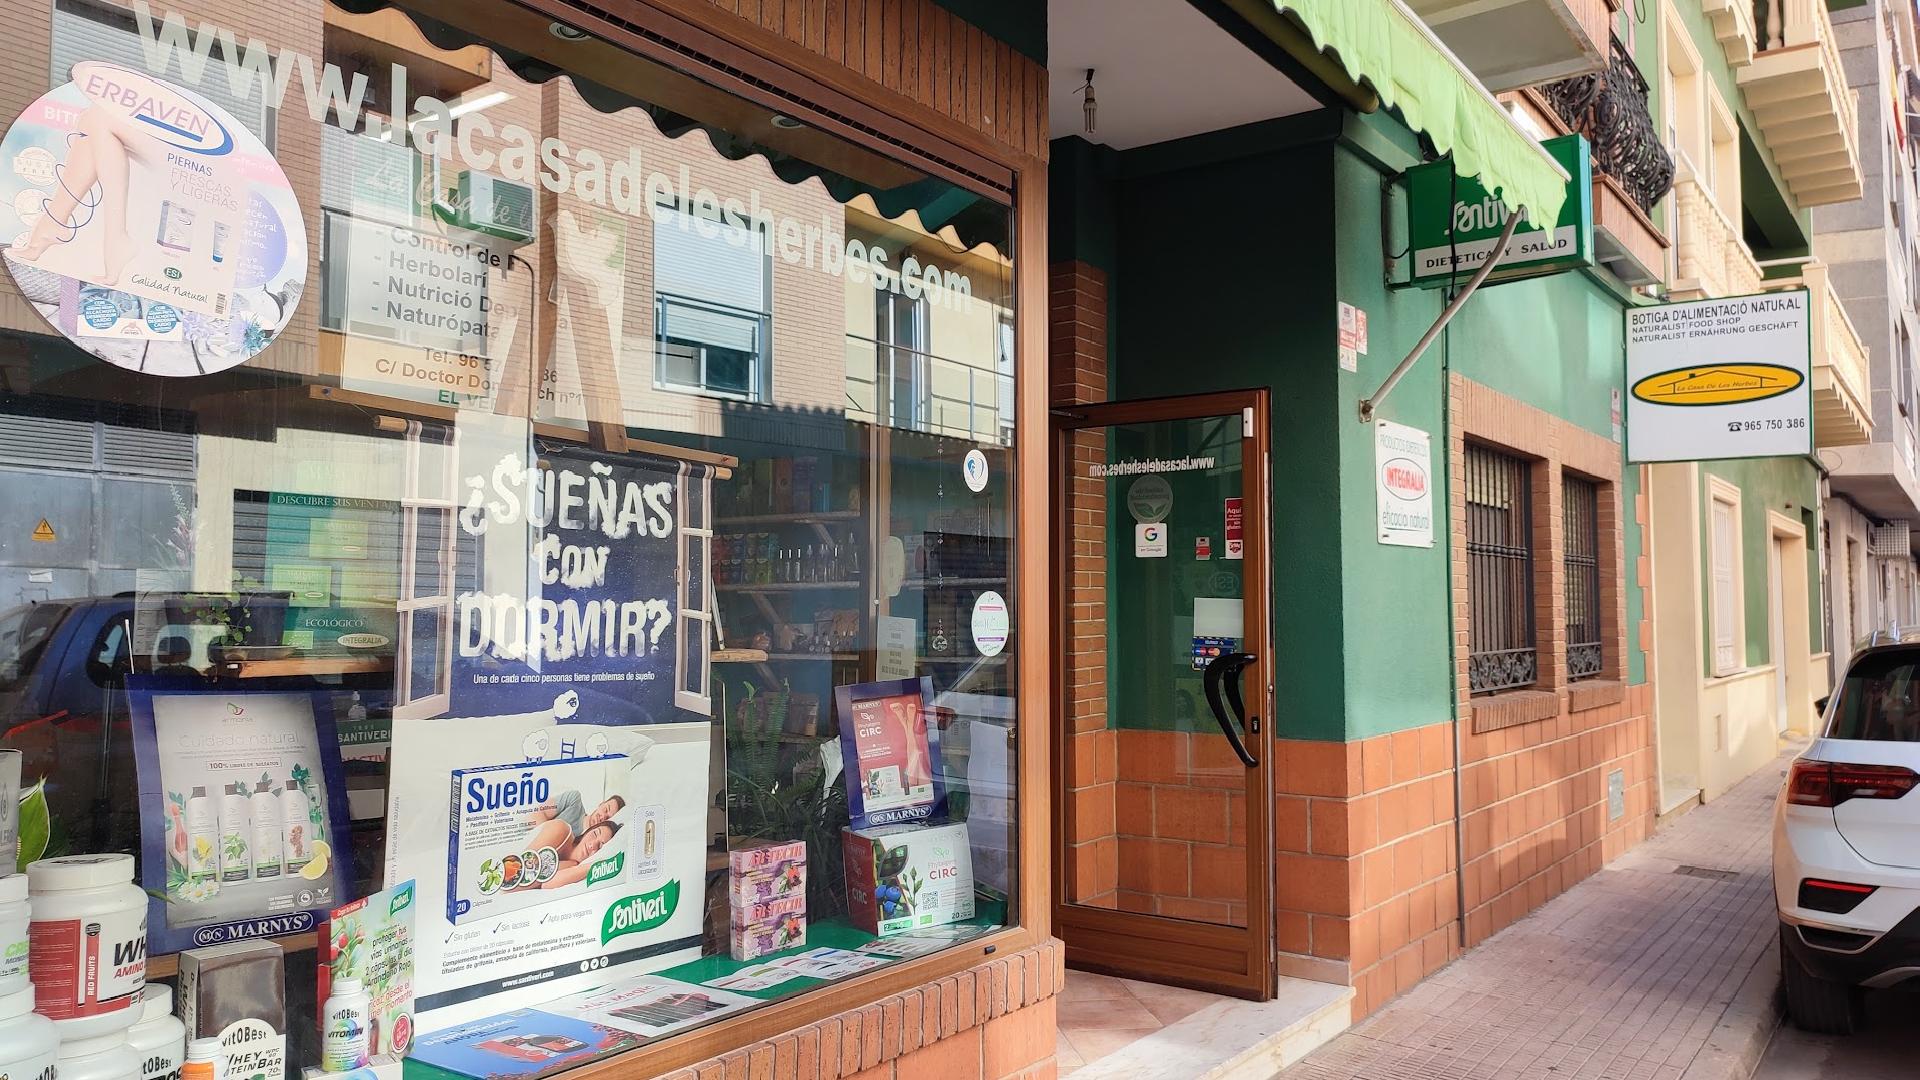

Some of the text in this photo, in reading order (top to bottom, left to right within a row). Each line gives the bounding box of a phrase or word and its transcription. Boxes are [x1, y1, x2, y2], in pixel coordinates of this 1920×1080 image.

[85, 74, 209, 135] ERBAVEN
[132, 0, 973, 314] www.lacasadelesherbes.com
[167, 152, 213, 177] PIERNAS
[171, 167, 232, 198] FRESCAS
[182, 183, 239, 212] LIGERAS
[390, 226, 470, 260] Control
[477, 248, 502, 268] de
[1520, 238, 1568, 254] SALUD
[166, 268, 181, 280] ESI
[388, 275, 473, 309] Nutrició
[386, 300, 500, 339] Naturópata
[1632, 297, 1801, 326] BOTIGA D'ALIMENTACIÓ NATURAL
[1632, 316, 1742, 334] NATURALIST FOOD SHOP
[1632, 332, 1686, 344] NATURALIST
[458, 353, 479, 369] 96
[402, 361, 464, 388] Doctor
[438, 388, 461, 405] EL
[1744, 418, 1805, 431] 965 750 386
[1386, 466, 1425, 492] INTEGRALIA
[277, 494, 351, 507] DESCUBRE SUS
[458, 452, 677, 540] ¿SUEÑAS
[532, 533, 610, 590] CON
[305, 615, 363, 628] ECOLÓGICO
[456, 591, 673, 662] DORMIR?
[342, 637, 382, 645] INTEGRALIA
[473, 671, 655, 686] Una de cada cinco personas tiene problemas de sueño
[337, 729, 392, 743] SANTIVERI
[859, 726, 882, 738] CIRC
[466, 772, 549, 814] Sueño
[929, 867, 958, 880] CIRC
[456, 902, 467, 914] 20
[608, 890, 668, 934] Santiveri
[453, 930, 481, 943] Sin gluten
[501, 923, 511, 932] Sin
[372, 929, 398, 949] proteger
[365, 966, 370, 977] 2
[397, 950, 403, 962] al
[442, 954, 479, 968] Complemento
[512, 943, 524, 952] base
[525, 942, 531, 950] de
[465, 962, 473, 970] de
[518, 951, 525, 959] de
[87, 955, 97, 996] RED FRUITS
[113, 962, 144, 979] AMINO
[398, 960, 412, 974] Rojo
[501, 970, 555, 989] www.santiveri.com
